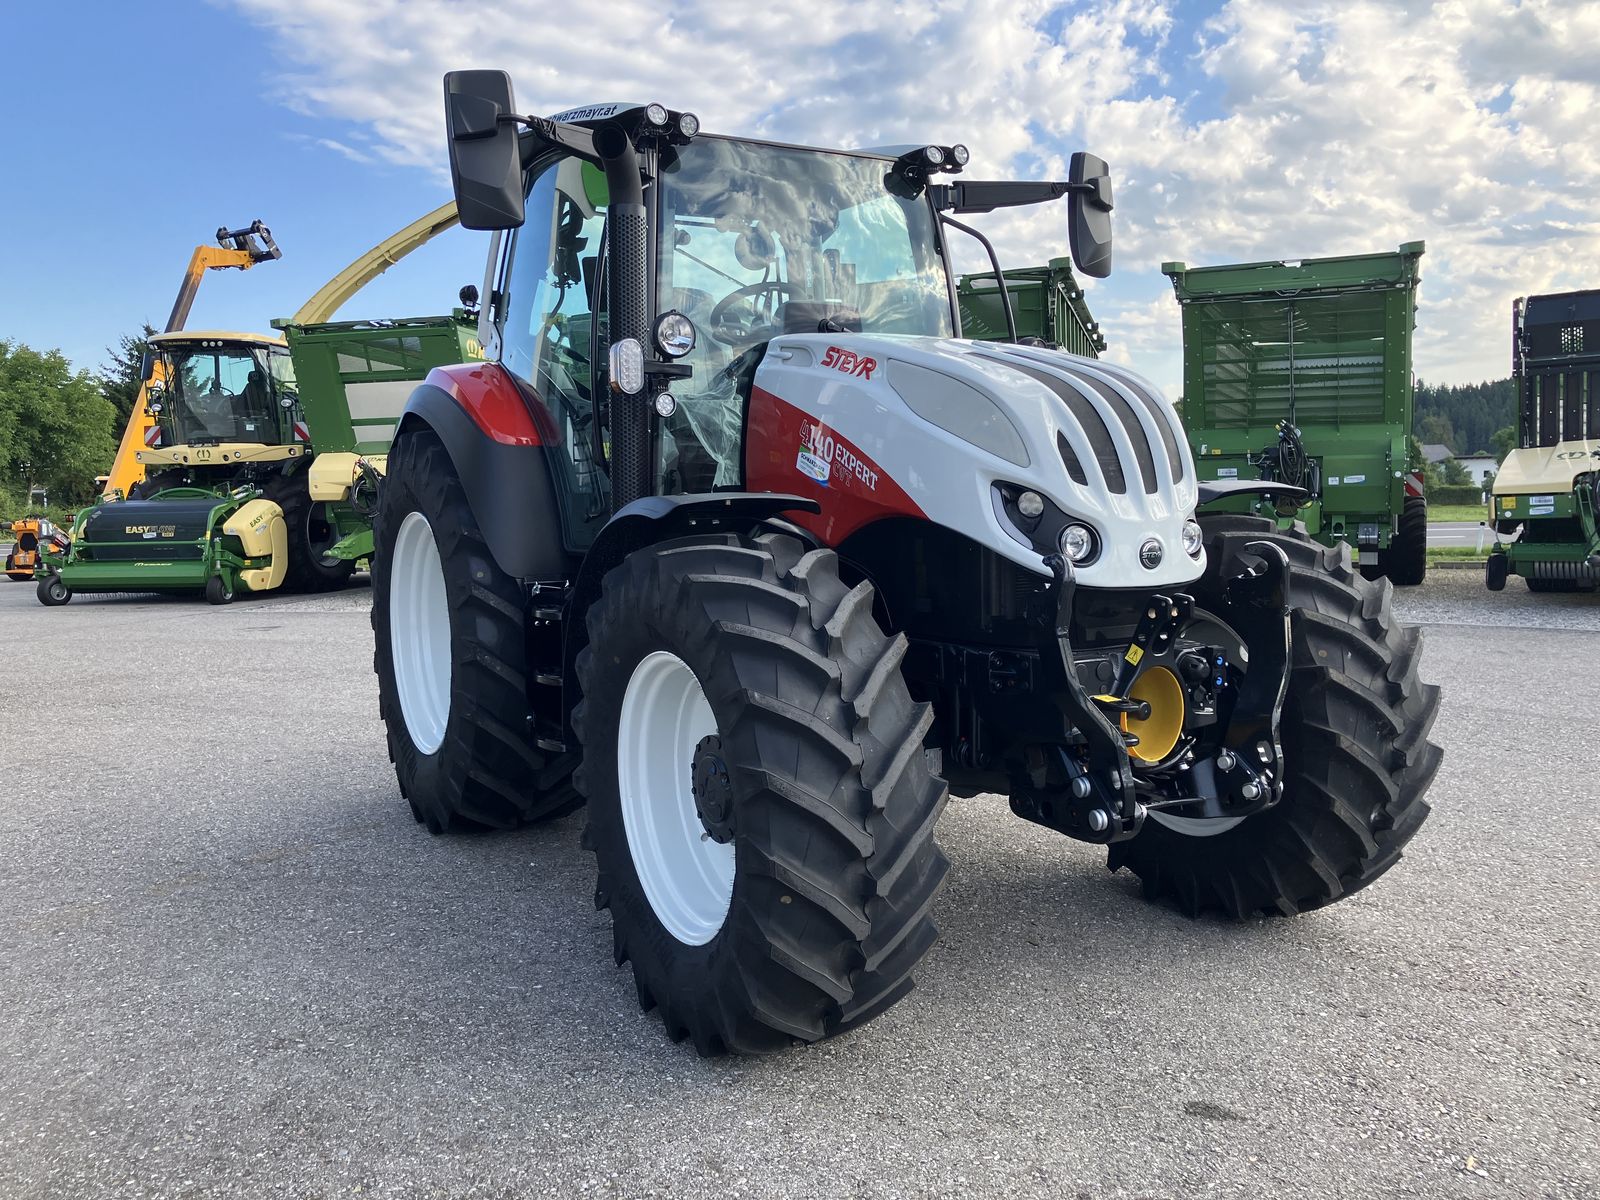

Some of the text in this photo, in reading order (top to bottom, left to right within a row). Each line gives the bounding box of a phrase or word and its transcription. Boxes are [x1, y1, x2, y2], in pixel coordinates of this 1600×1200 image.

[820, 345, 877, 380] STEYR
[799, 418, 878, 492] 4140 EXPERT
[832, 461, 853, 488] CVT
[249, 514, 264, 528] EASY
